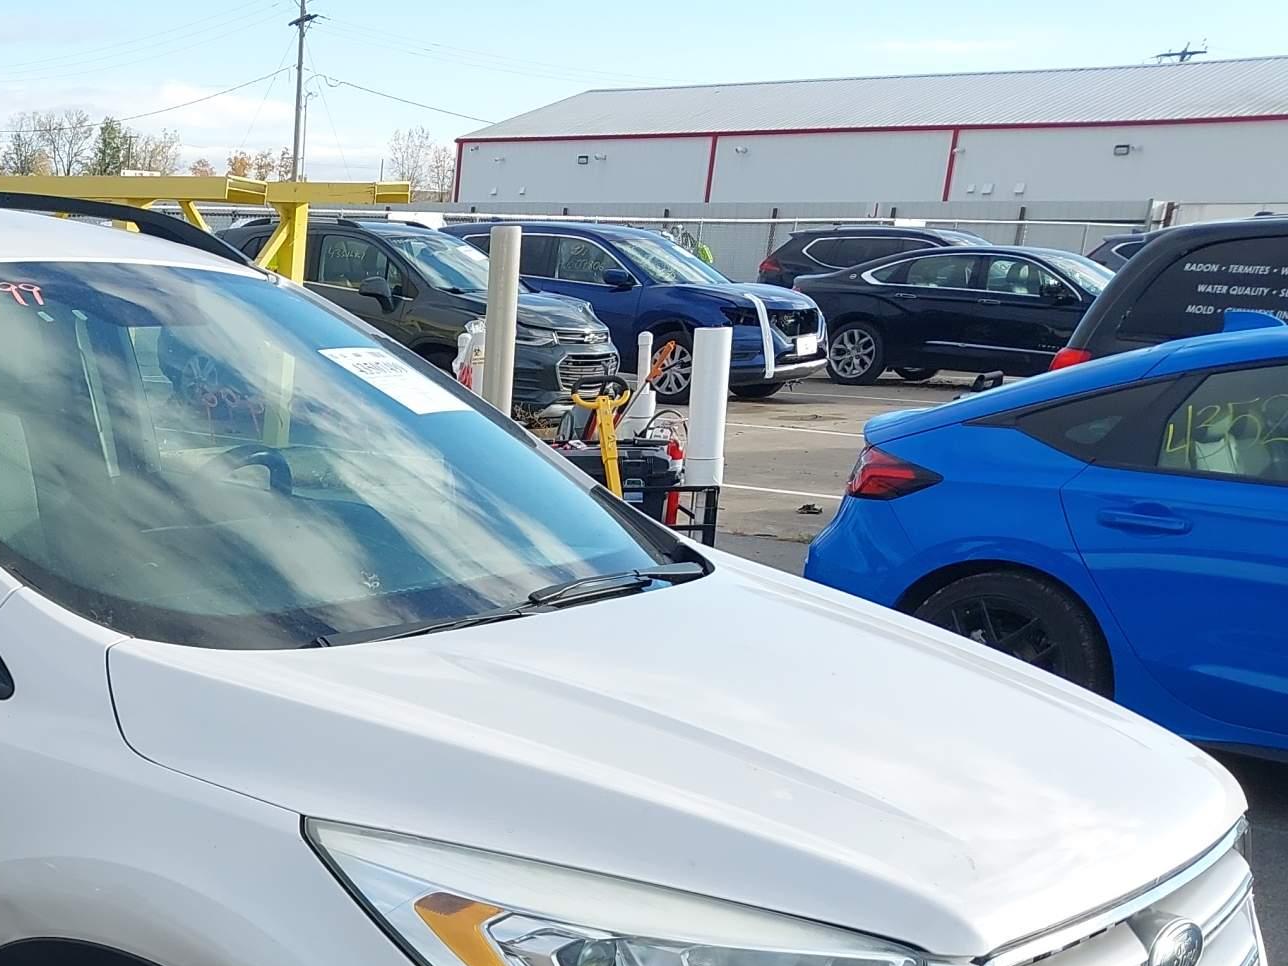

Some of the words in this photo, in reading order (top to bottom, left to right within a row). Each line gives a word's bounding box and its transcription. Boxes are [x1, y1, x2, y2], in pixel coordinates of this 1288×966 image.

[1184, 263, 1219, 272] RADON
[1228, 264, 1271, 275] TERMITES
[1197, 284, 1228, 294] WATER
[1229, 286, 1270, 296] QUALITY
[1185, 305, 1214, 315] MOLD
